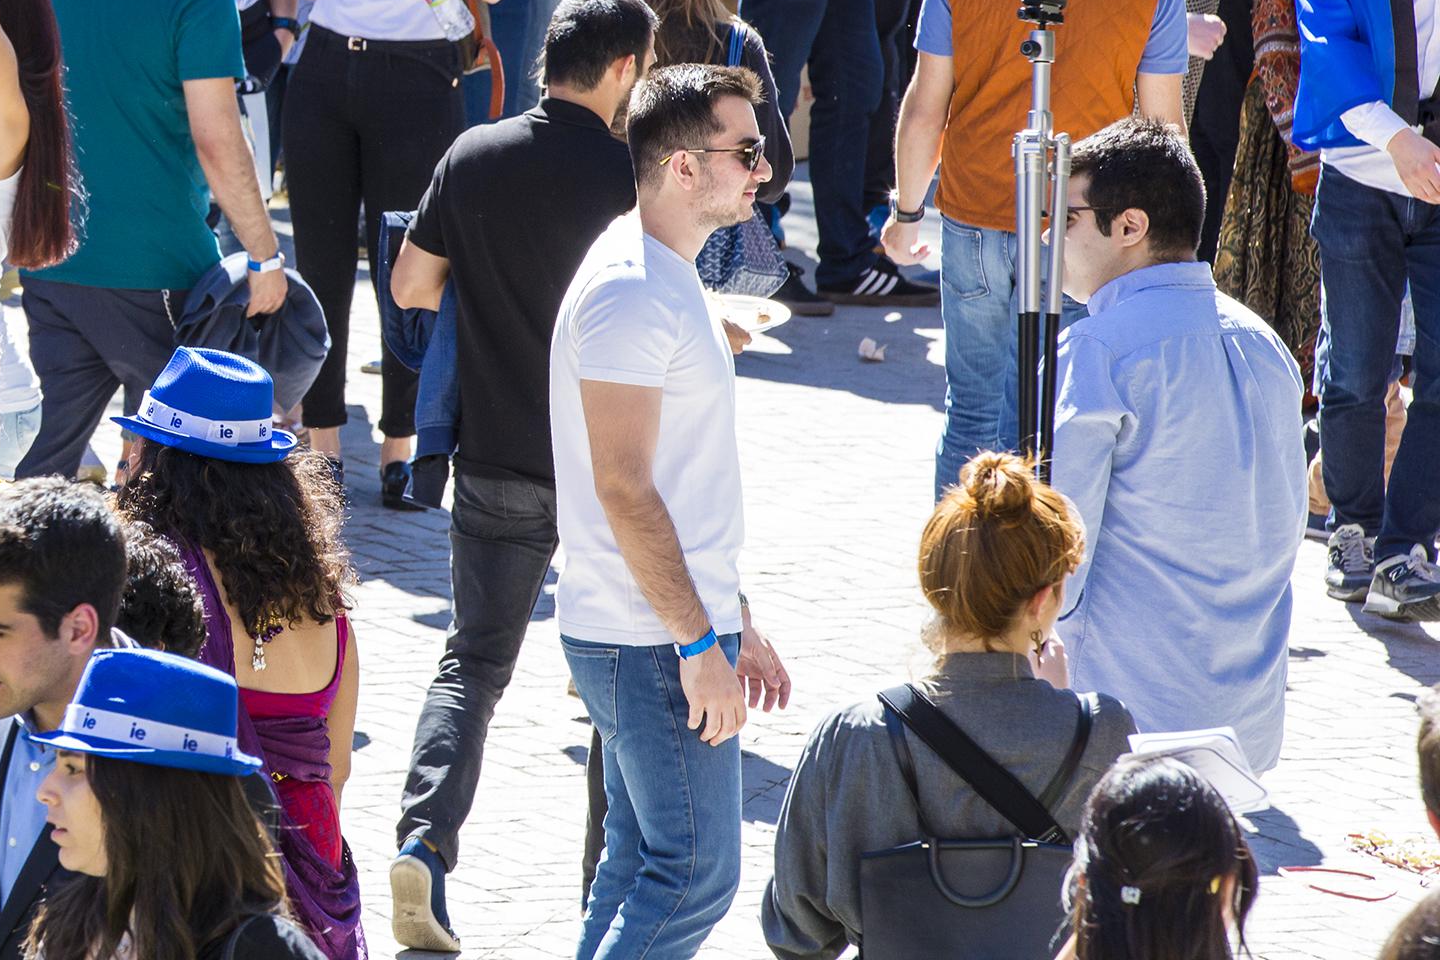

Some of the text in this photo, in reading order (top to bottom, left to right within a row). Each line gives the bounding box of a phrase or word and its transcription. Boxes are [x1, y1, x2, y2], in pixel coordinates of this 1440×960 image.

[170, 412, 183, 428] ie
[219, 424, 234, 439] ie
[259, 423, 267, 438] ie
[82, 712, 96, 730] ie
[129, 722, 146, 740] ie
[182, 733, 198, 752] ie
